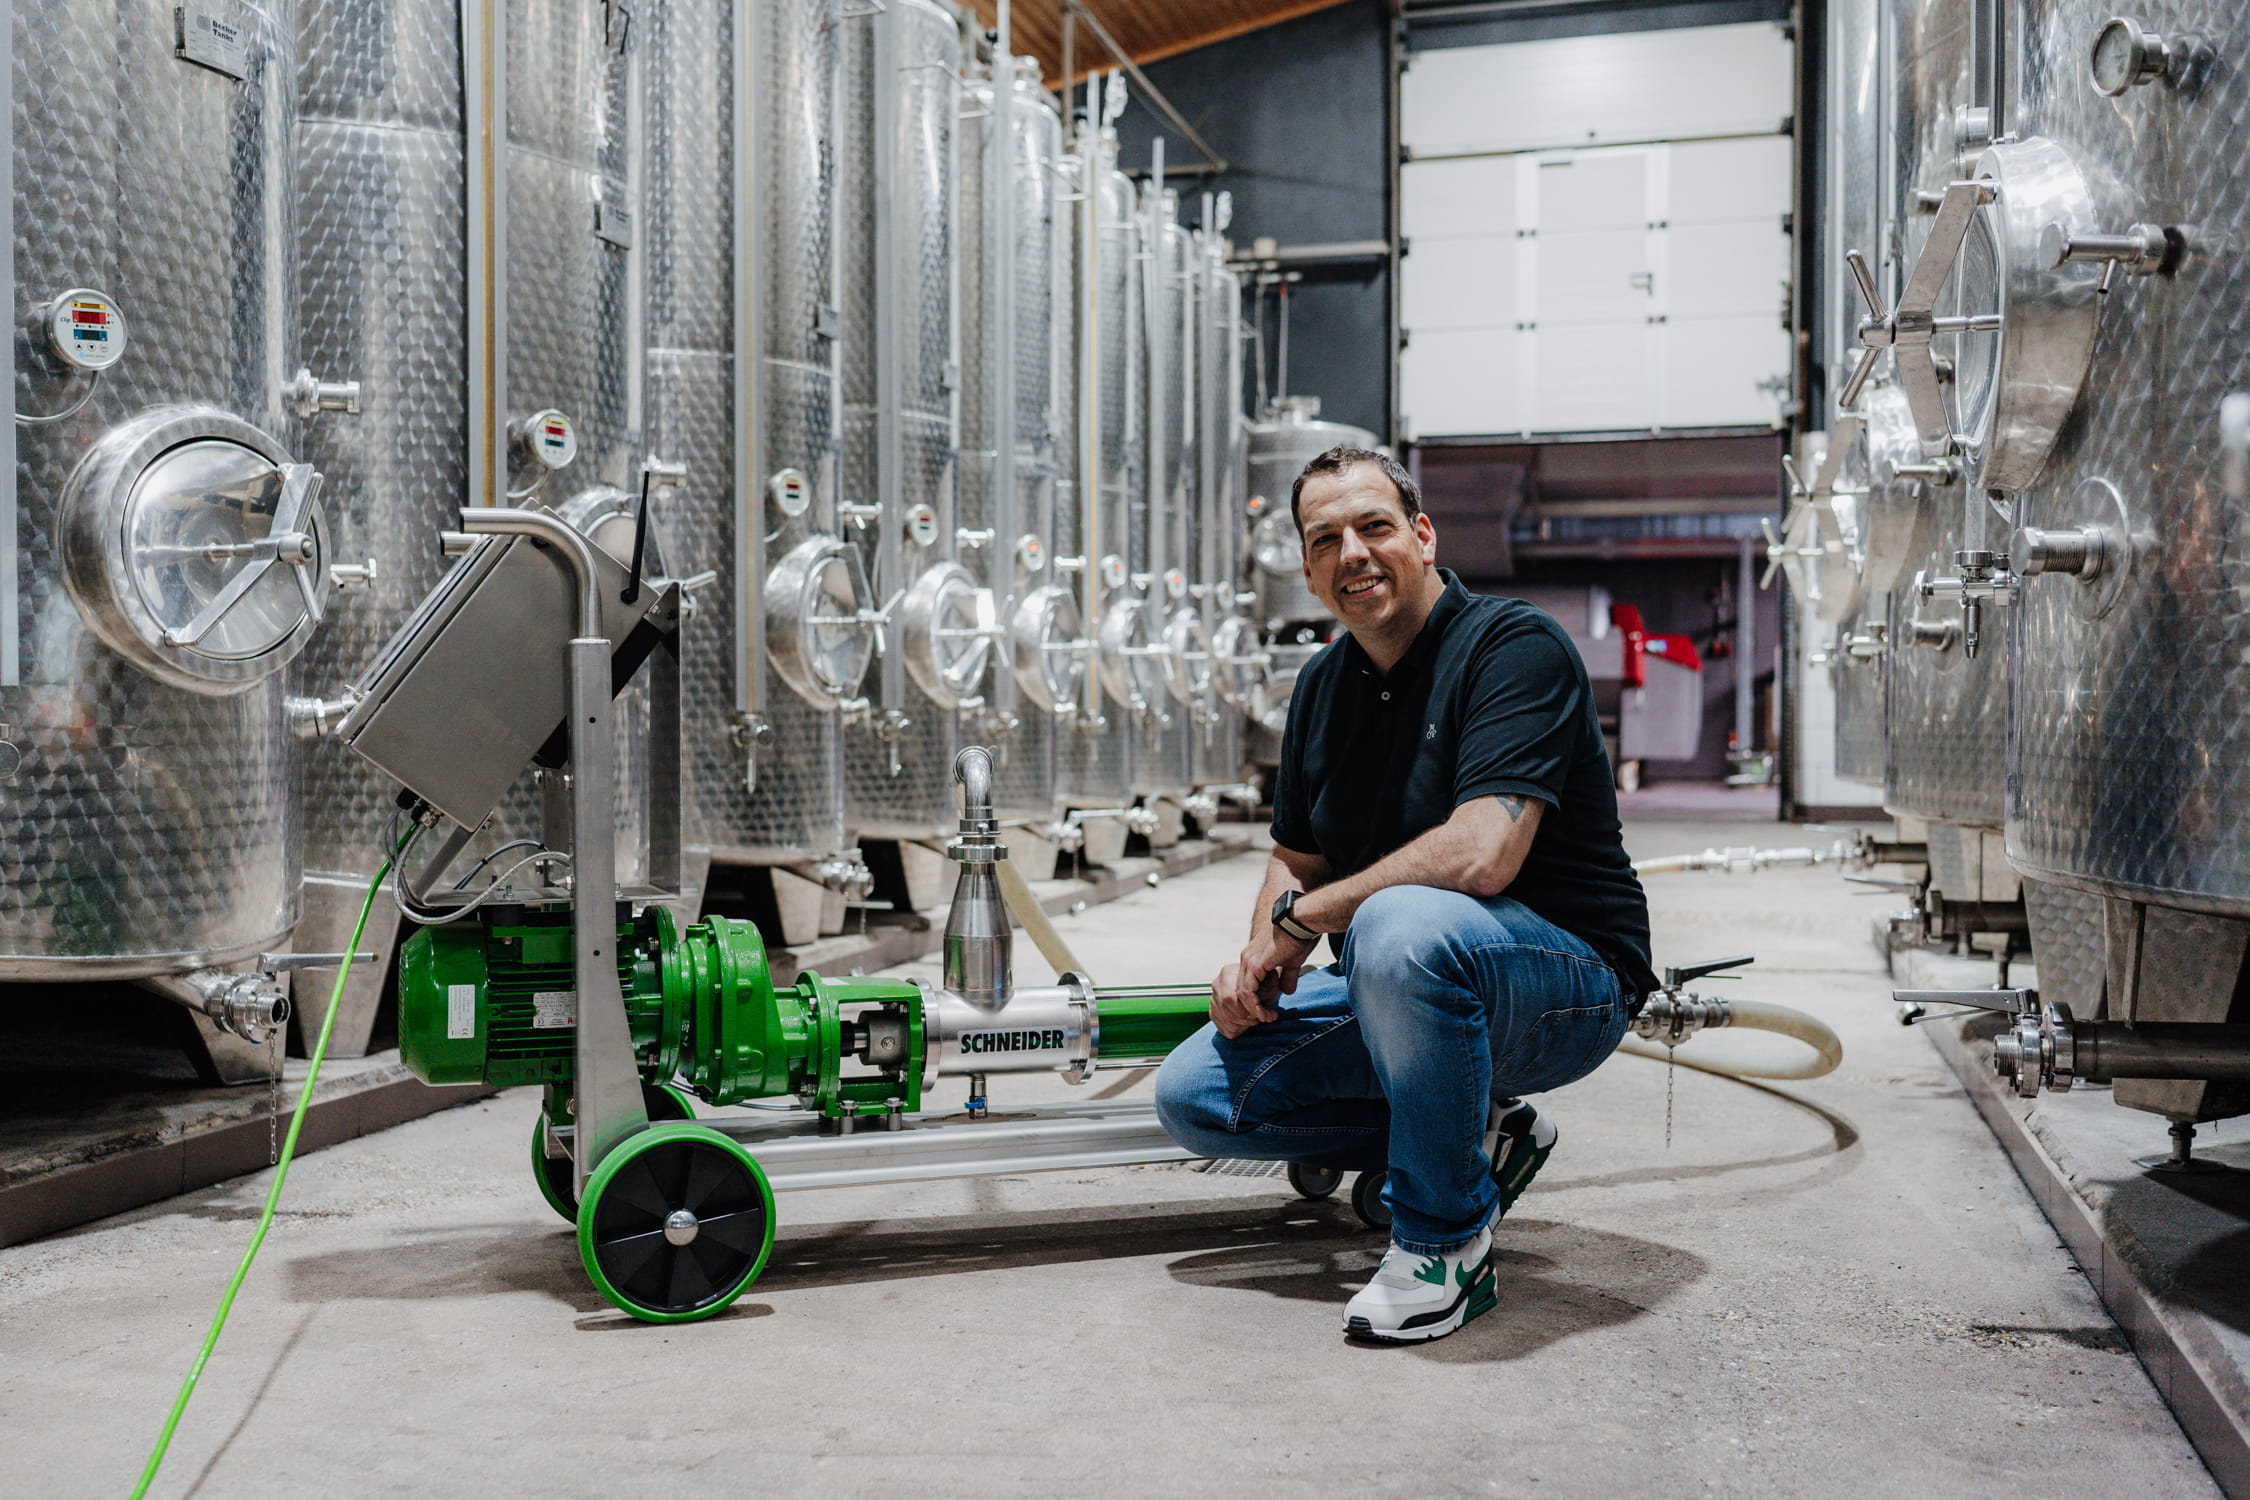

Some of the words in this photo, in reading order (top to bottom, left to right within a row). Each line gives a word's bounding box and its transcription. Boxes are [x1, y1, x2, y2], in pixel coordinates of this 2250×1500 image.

[212, 20, 238, 36] Becker
[213, 28, 234, 43] Tanks
[961, 1029, 1064, 1054] SCHNEIDER
